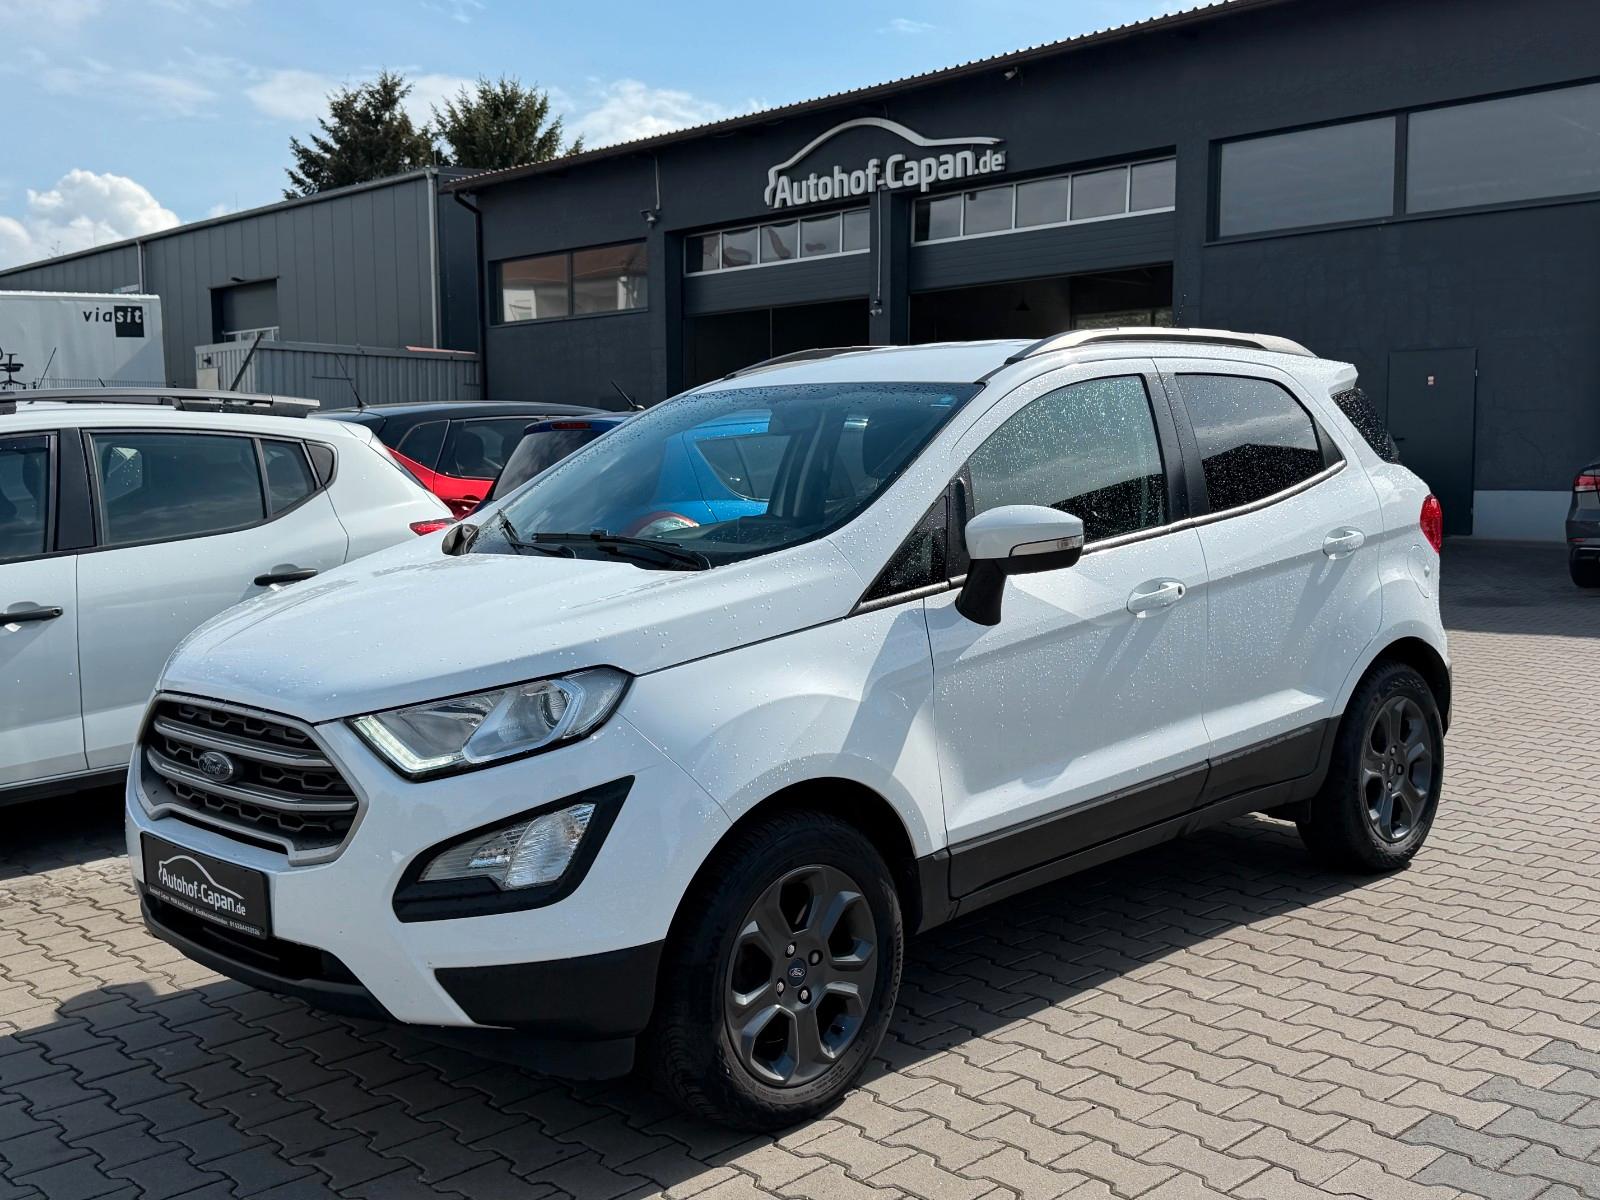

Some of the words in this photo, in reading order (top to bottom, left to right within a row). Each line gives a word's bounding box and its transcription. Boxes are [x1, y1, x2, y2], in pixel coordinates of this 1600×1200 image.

[773, 150, 1006, 208] Autohof-Capan.de
[83, 307, 142, 323] viasit
[162, 867, 246, 916] Autohof-Capan.de
